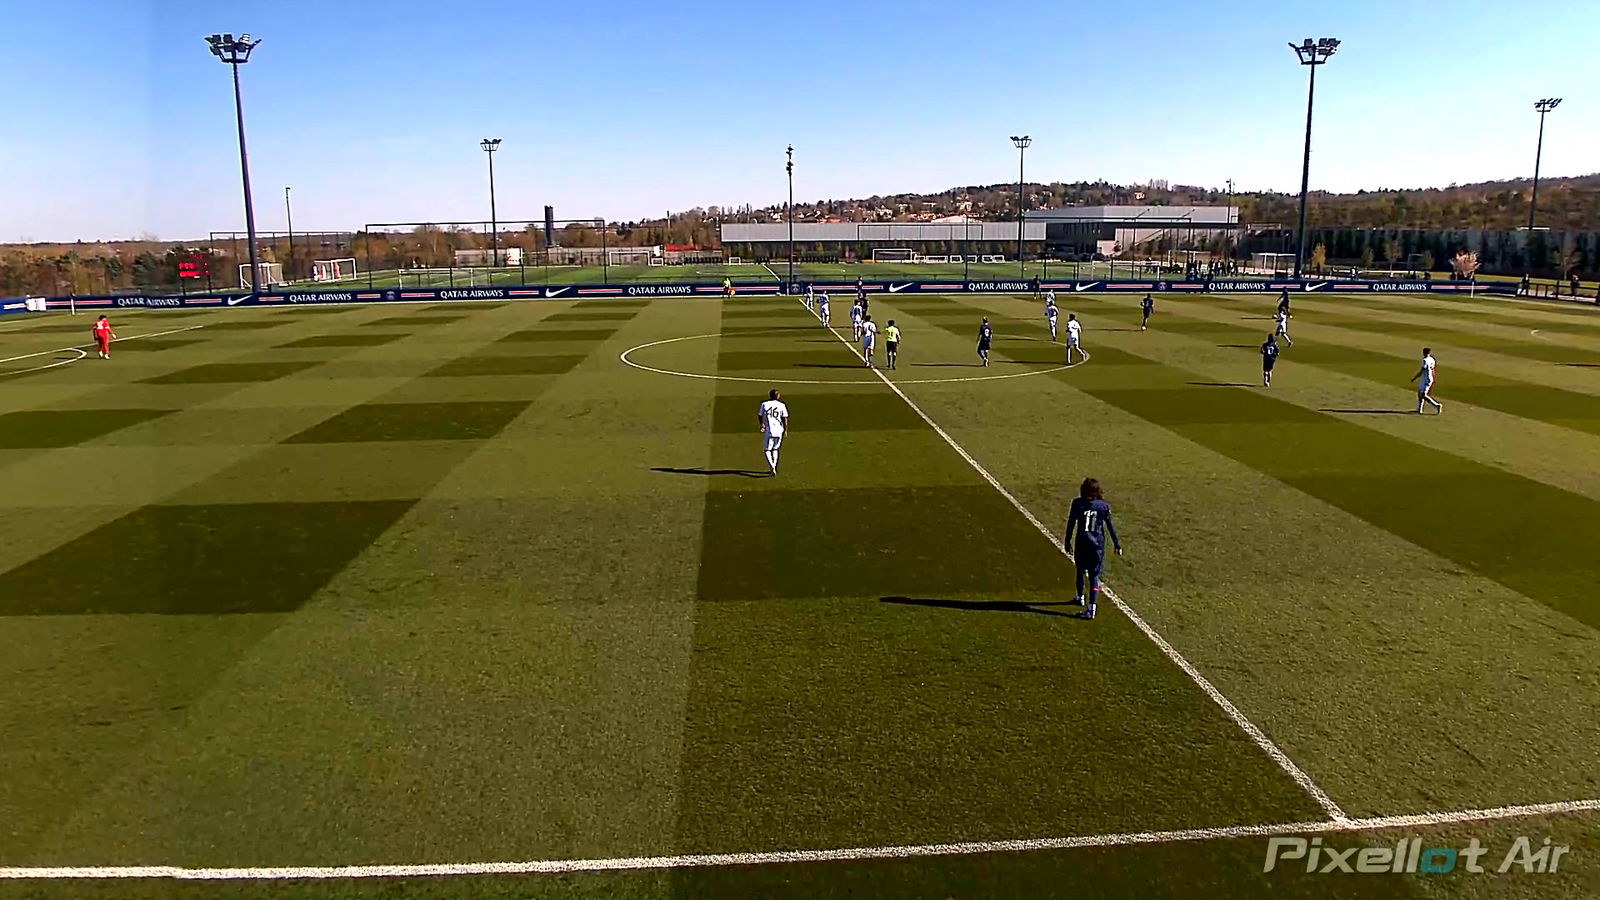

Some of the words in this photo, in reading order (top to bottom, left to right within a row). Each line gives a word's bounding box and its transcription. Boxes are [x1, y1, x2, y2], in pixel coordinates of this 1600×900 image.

[628, 286, 656, 295] QATAR
[657, 286, 691, 294] AIRWAYS
[968, 282, 994, 291] QATAR
[1209, 282, 1234, 290] QATAR
[1235, 282, 1265, 290] AIRWAYS
[1373, 283, 1396, 291] QATAR
[289, 294, 316, 303] QATAR
[318, 293, 351, 301] AIRWAYS
[440, 290, 468, 299] QATAR
[470, 290, 503, 298] AIRWAYS
[118, 298, 144, 306] QATAR
